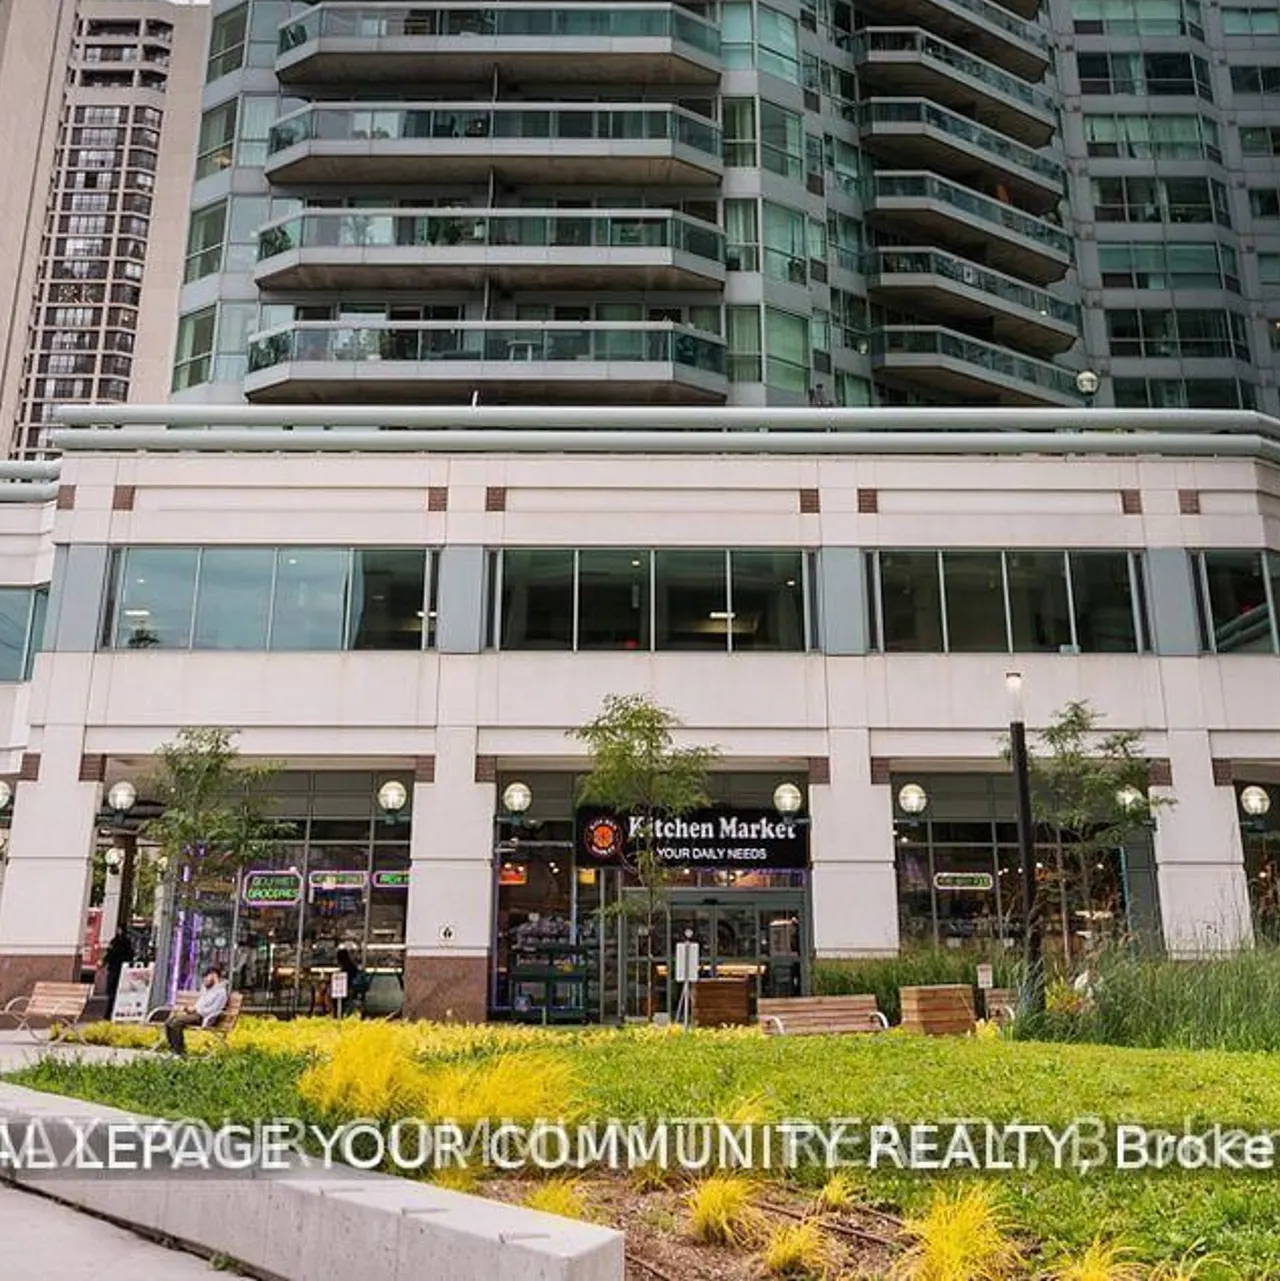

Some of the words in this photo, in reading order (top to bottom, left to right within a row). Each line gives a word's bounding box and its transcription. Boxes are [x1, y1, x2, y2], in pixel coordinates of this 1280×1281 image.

[627, 815, 714, 838] Kitchen
[718, 816, 797, 839] Market
[656, 848, 690, 860] YOUR
[692, 848, 726, 860] DAILY
[727, 848, 767, 860] NEEDS
